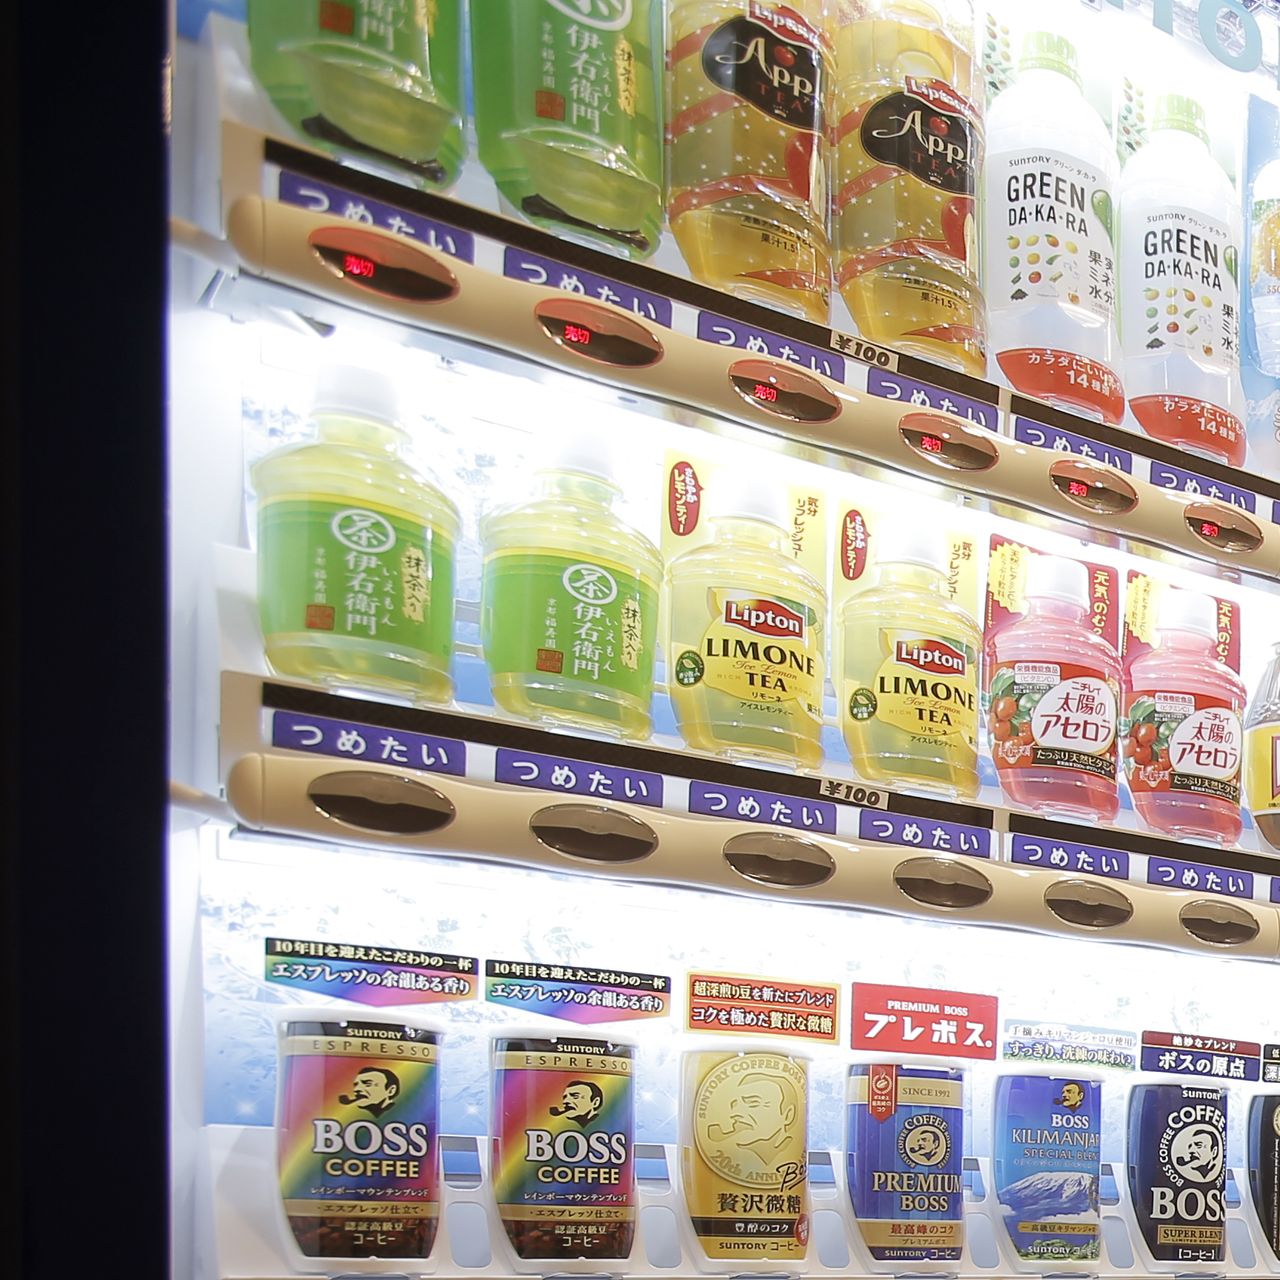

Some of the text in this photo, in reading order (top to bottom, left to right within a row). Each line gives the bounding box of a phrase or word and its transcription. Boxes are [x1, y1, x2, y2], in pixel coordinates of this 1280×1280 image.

[567, 23, 600, 132] 伊右衛門
[1007, 172, 1085, 213] GREEN
[1144, 229, 1218, 268] GREEN
[343, 255, 374, 278] 売切
[565, 325, 590, 345] 売切
[754, 384, 777, 402] 売切
[343, 514, 384, 546] 茶
[345, 552, 380, 634] 伊右衛門
[573, 570, 605, 597] 茶
[729, 602, 800, 633] Lipton
[573, 603, 605, 680] 伊右衛門
[707, 637, 815, 677] LIMONE
[900, 642, 963, 671] Lipton
[745, 671, 787, 693] TEA
[879, 675, 974, 712] LIMONE
[1071, 680, 1101, 694] ニチレイ
[1056, 693, 1106, 716] 太陽の
[917, 708, 953, 726] TEA
[1039, 713, 1112, 744] アセロラ
[293, 723, 449, 767] つめたい
[1190, 722, 1233, 744] 太陽の
[1176, 742, 1238, 769] アセロラ
[825, 781, 880, 806] ¥100
[705, 791, 824, 828] つめたい
[872, 819, 979, 851] つめたい
[1158, 864, 1247, 893] つめたい
[274, 940, 473, 971] 10年目を迎えたこだわりの一杯
[272, 962, 470, 996] エスプレッソの余韻ある香り
[493, 962, 665, 989] 10年目を迎えたこだわりの一杯
[490, 983, 664, 1012] エスプレッソの余韻ある香り
[693, 981, 834, 1008] 超深煎り豆を新たにブレンド
[692, 1007, 832, 1034] コクを極めた贅沢な微糖
[887, 1000, 968, 1017] PREMIUM BOSS
[347, 1028, 402, 1040] SUNTORY
[313, 1040, 431, 1058] ESPRESSO
[557, 1043, 605, 1054] SUNTORY
[525, 1054, 629, 1071] ESPRESSO
[1158, 1053, 1246, 1079] ボスの原点
[901, 1086, 951, 1100] SINCE 1992
[903, 1114, 949, 1132] COFFEE
[1051, 1114, 1089, 1129] BOSS
[313, 1118, 429, 1158] BOSS
[525, 1129, 627, 1165] BOSS
[1024, 1148, 1072, 1159] SPECIAL
[325, 1158, 419, 1178] COFFEE
[538, 1165, 620, 1185] COFFEE
[872, 1171, 961, 1194] PREMIUM
[717, 1192, 801, 1214] 贅沢微糖
[900, 1193, 949, 1213] BOSS
[353, 1233, 396, 1246] コーヒー
[562, 1236, 599, 1247] コーヒー
[719, 1241, 767, 1250] SUNTORY
[1163, 1228, 1197, 1240] SUPER
[884, 1248, 927, 1259] SUNTORY
